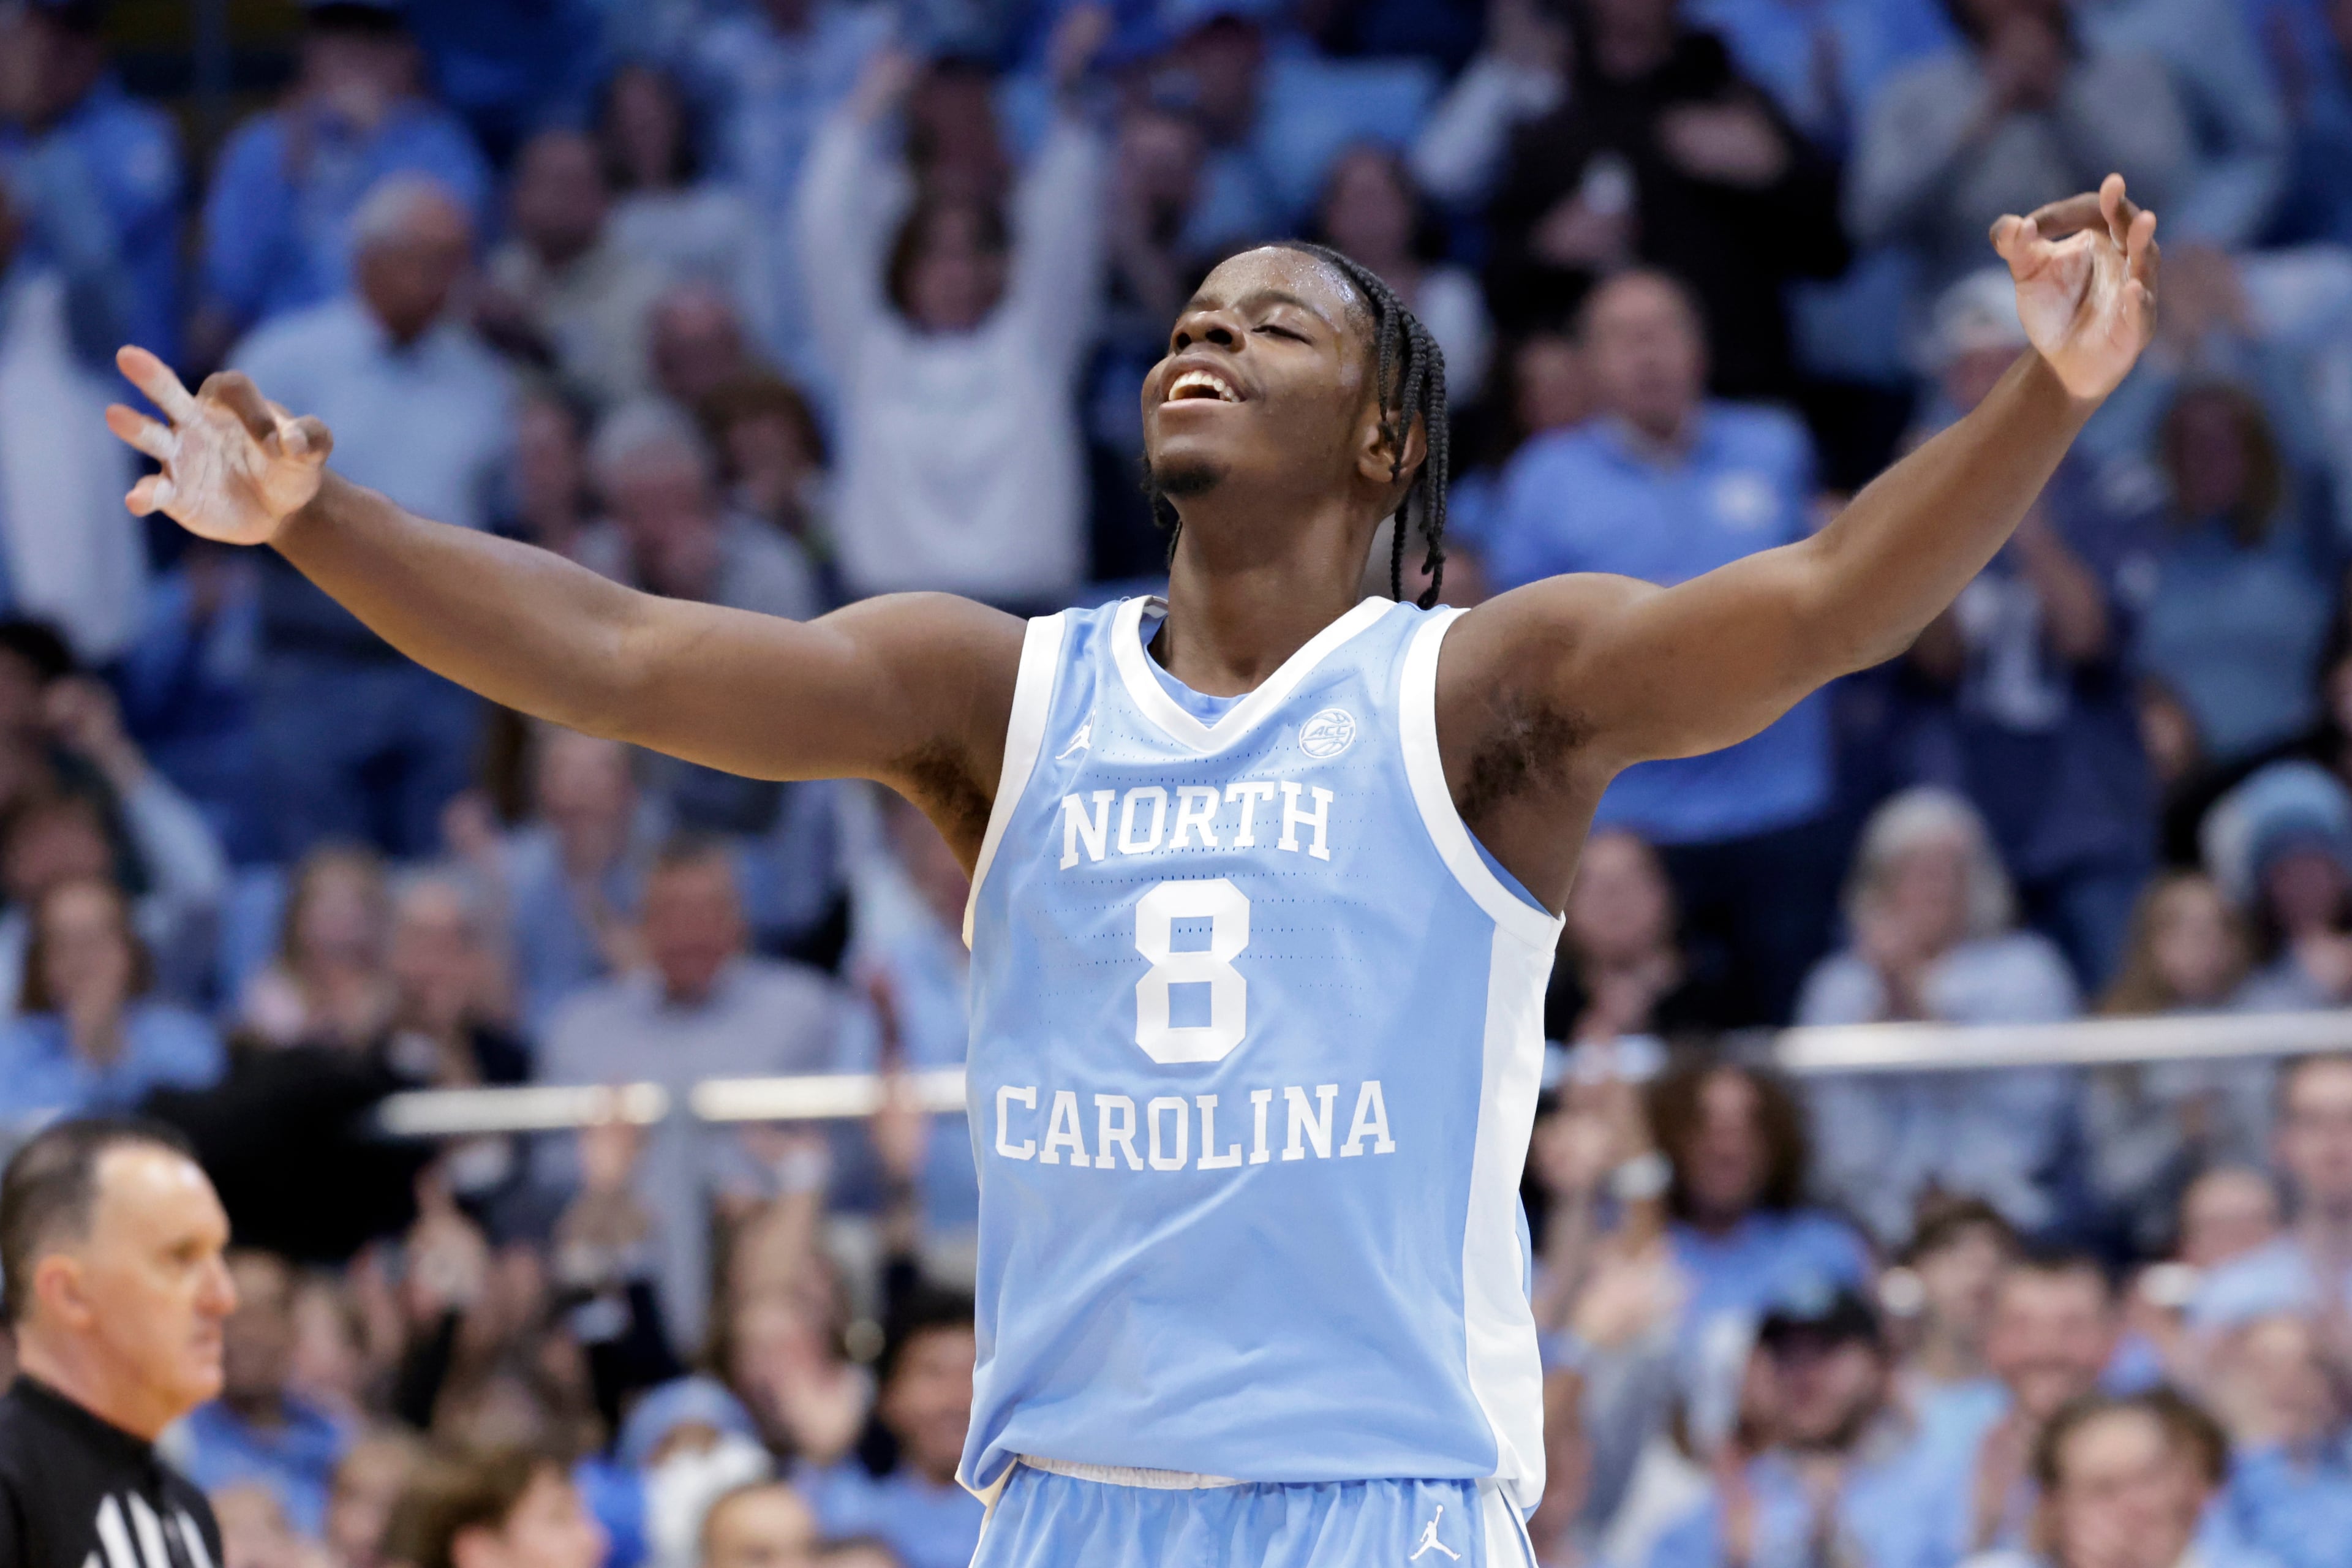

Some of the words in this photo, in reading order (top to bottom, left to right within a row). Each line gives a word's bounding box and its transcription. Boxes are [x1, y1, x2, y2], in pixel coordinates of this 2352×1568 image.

[1060, 780, 1334, 870] NORTH
[1134, 878, 1250, 1064] 8
[995, 1080, 1396, 1171] CAROLINA
